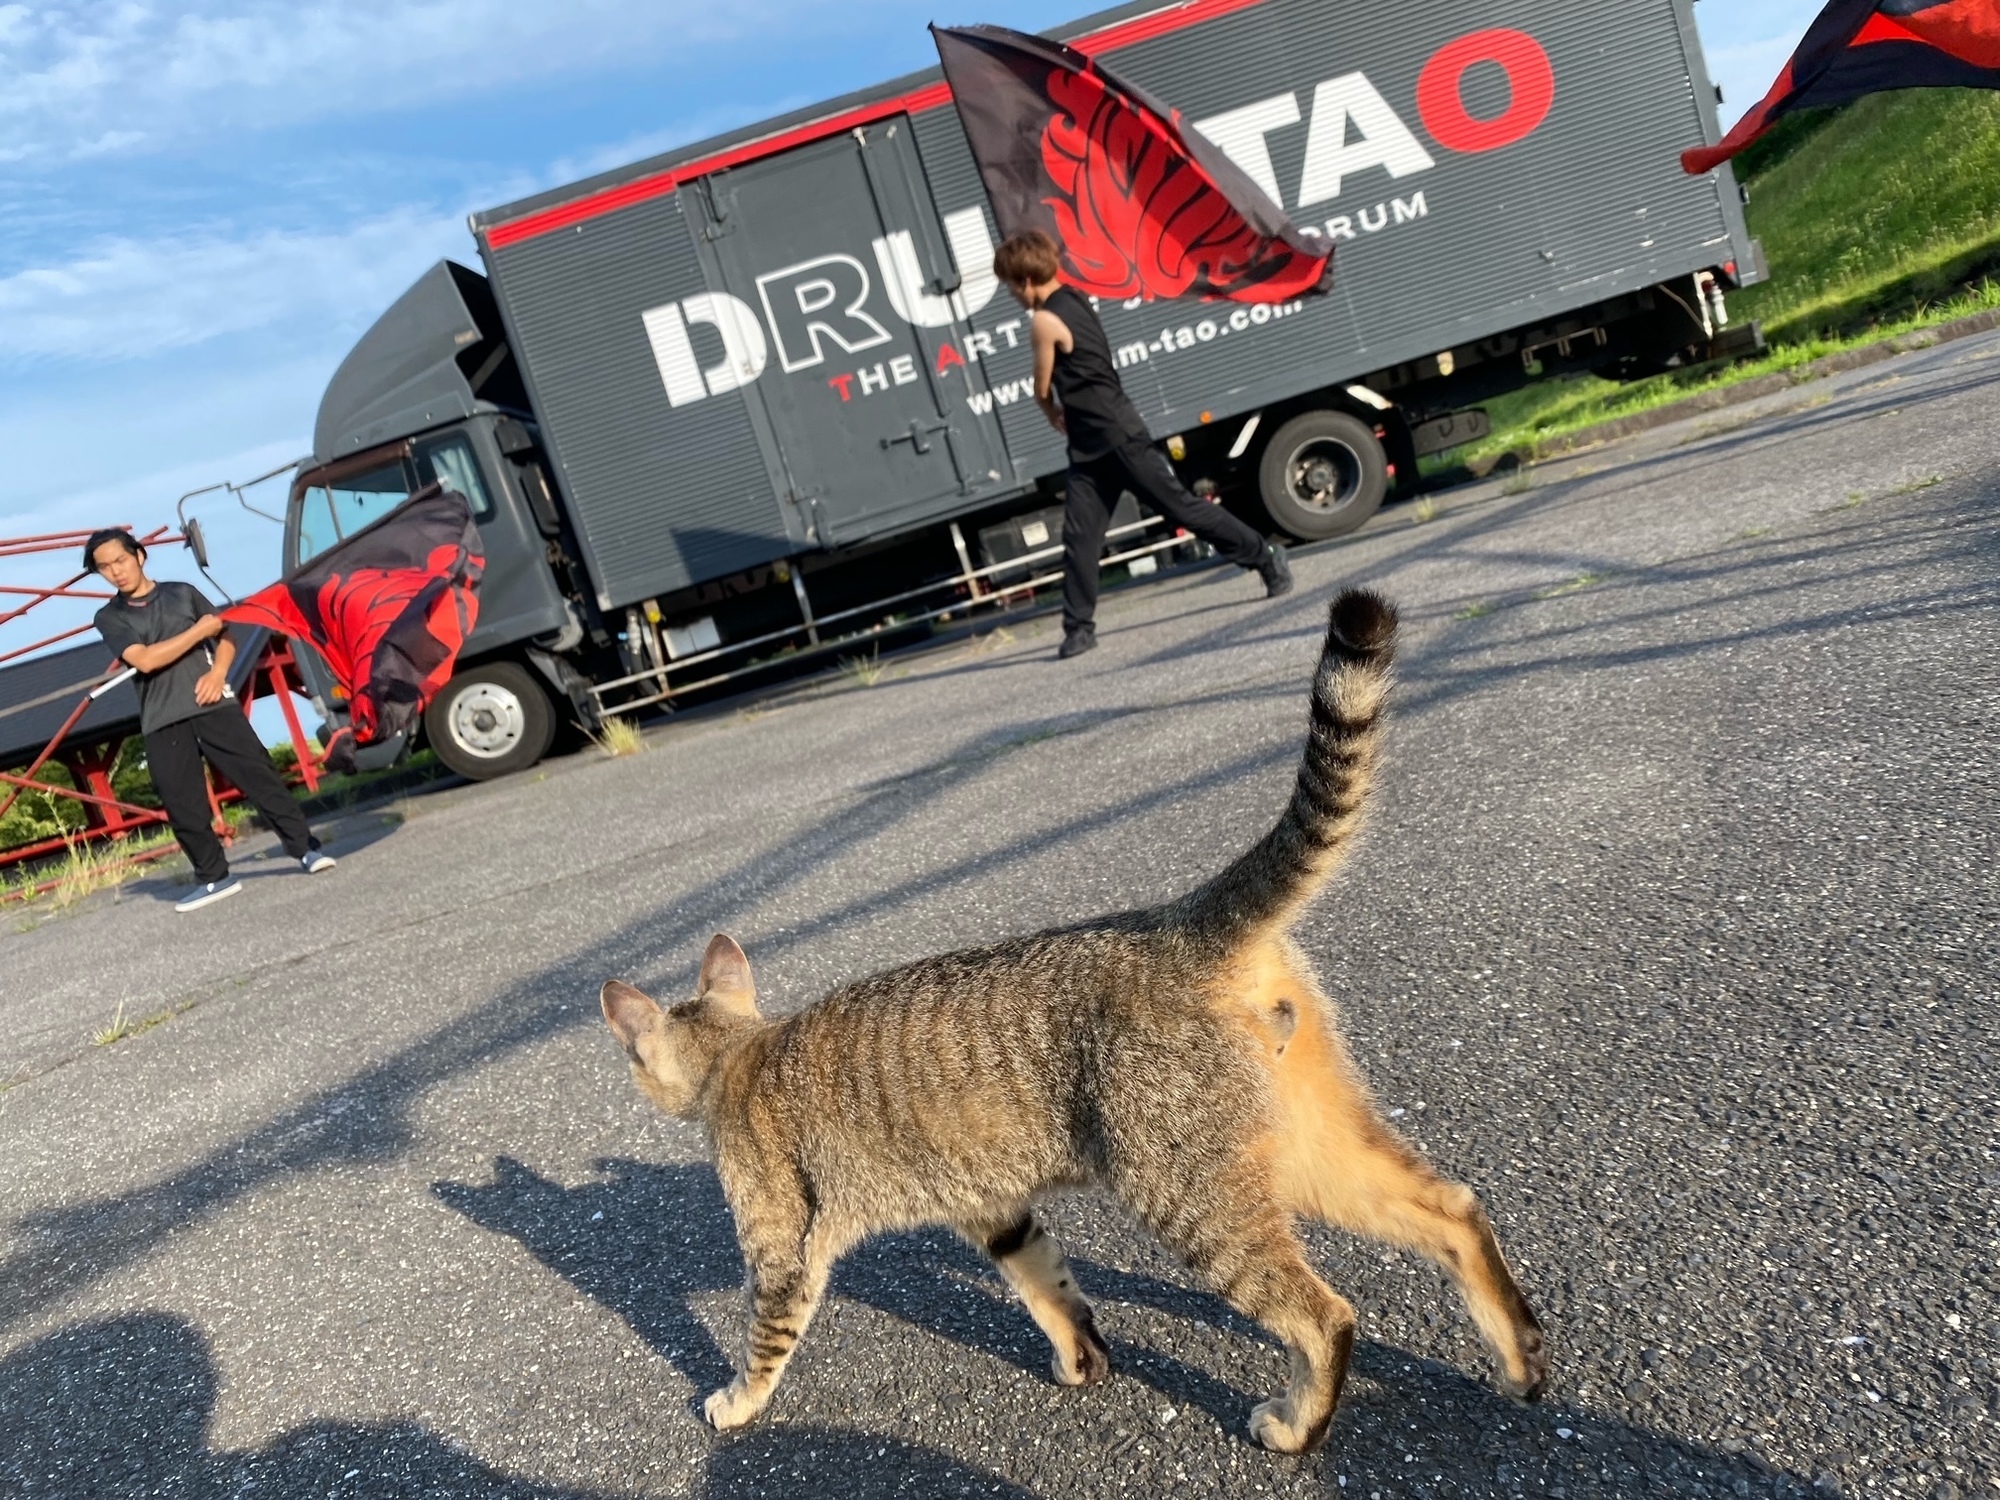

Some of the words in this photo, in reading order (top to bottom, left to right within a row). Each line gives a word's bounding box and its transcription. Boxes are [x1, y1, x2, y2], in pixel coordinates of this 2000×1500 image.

[641, 206, 1000, 408] DRU
[1192, 27, 1555, 210] TAO
[828, 354, 919, 402] THE
[935, 319, 1022, 374] ART
[1112, 300, 1303, 370] m-tao.com
